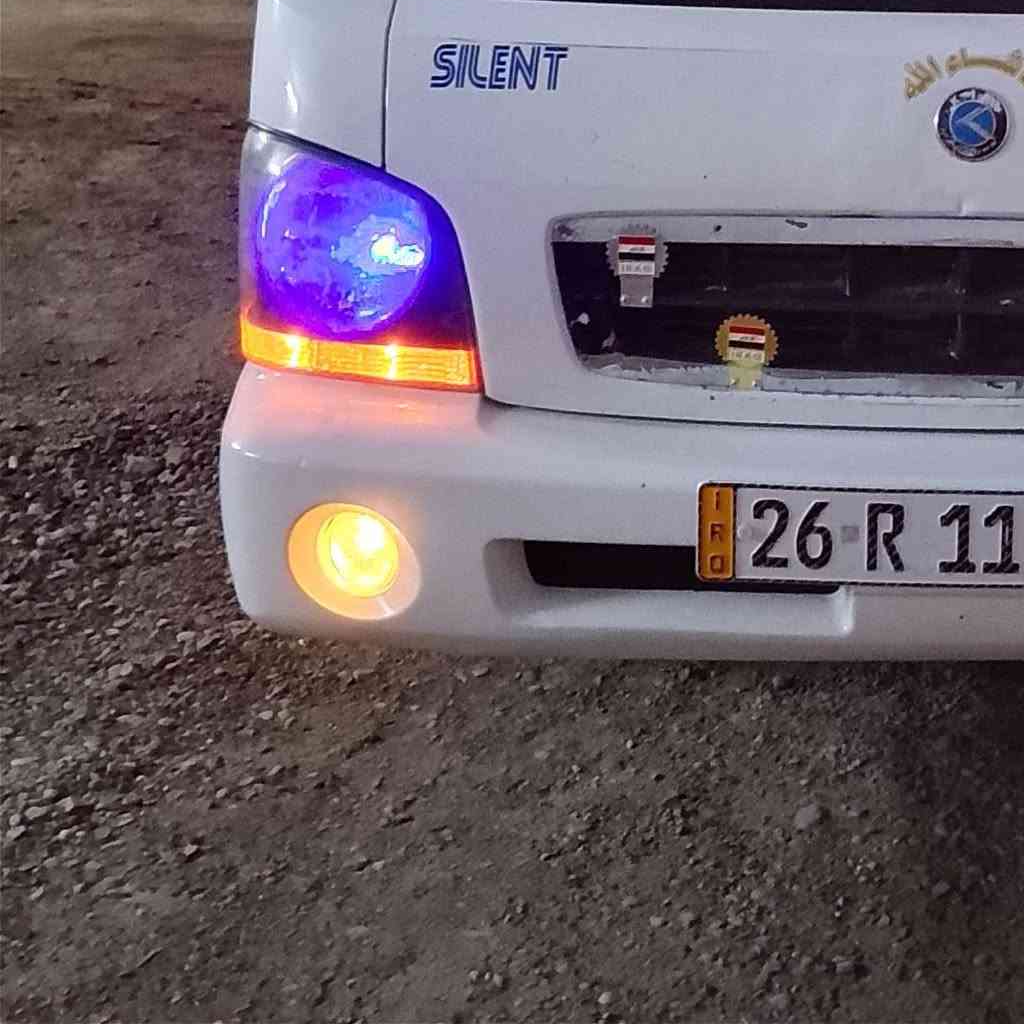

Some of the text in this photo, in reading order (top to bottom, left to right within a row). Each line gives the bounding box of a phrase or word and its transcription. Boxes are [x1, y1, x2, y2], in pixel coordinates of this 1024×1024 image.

[430, 43, 569, 90] SILENT
[751, 499, 834, 570] 26
[866, 502, 905, 572] R
